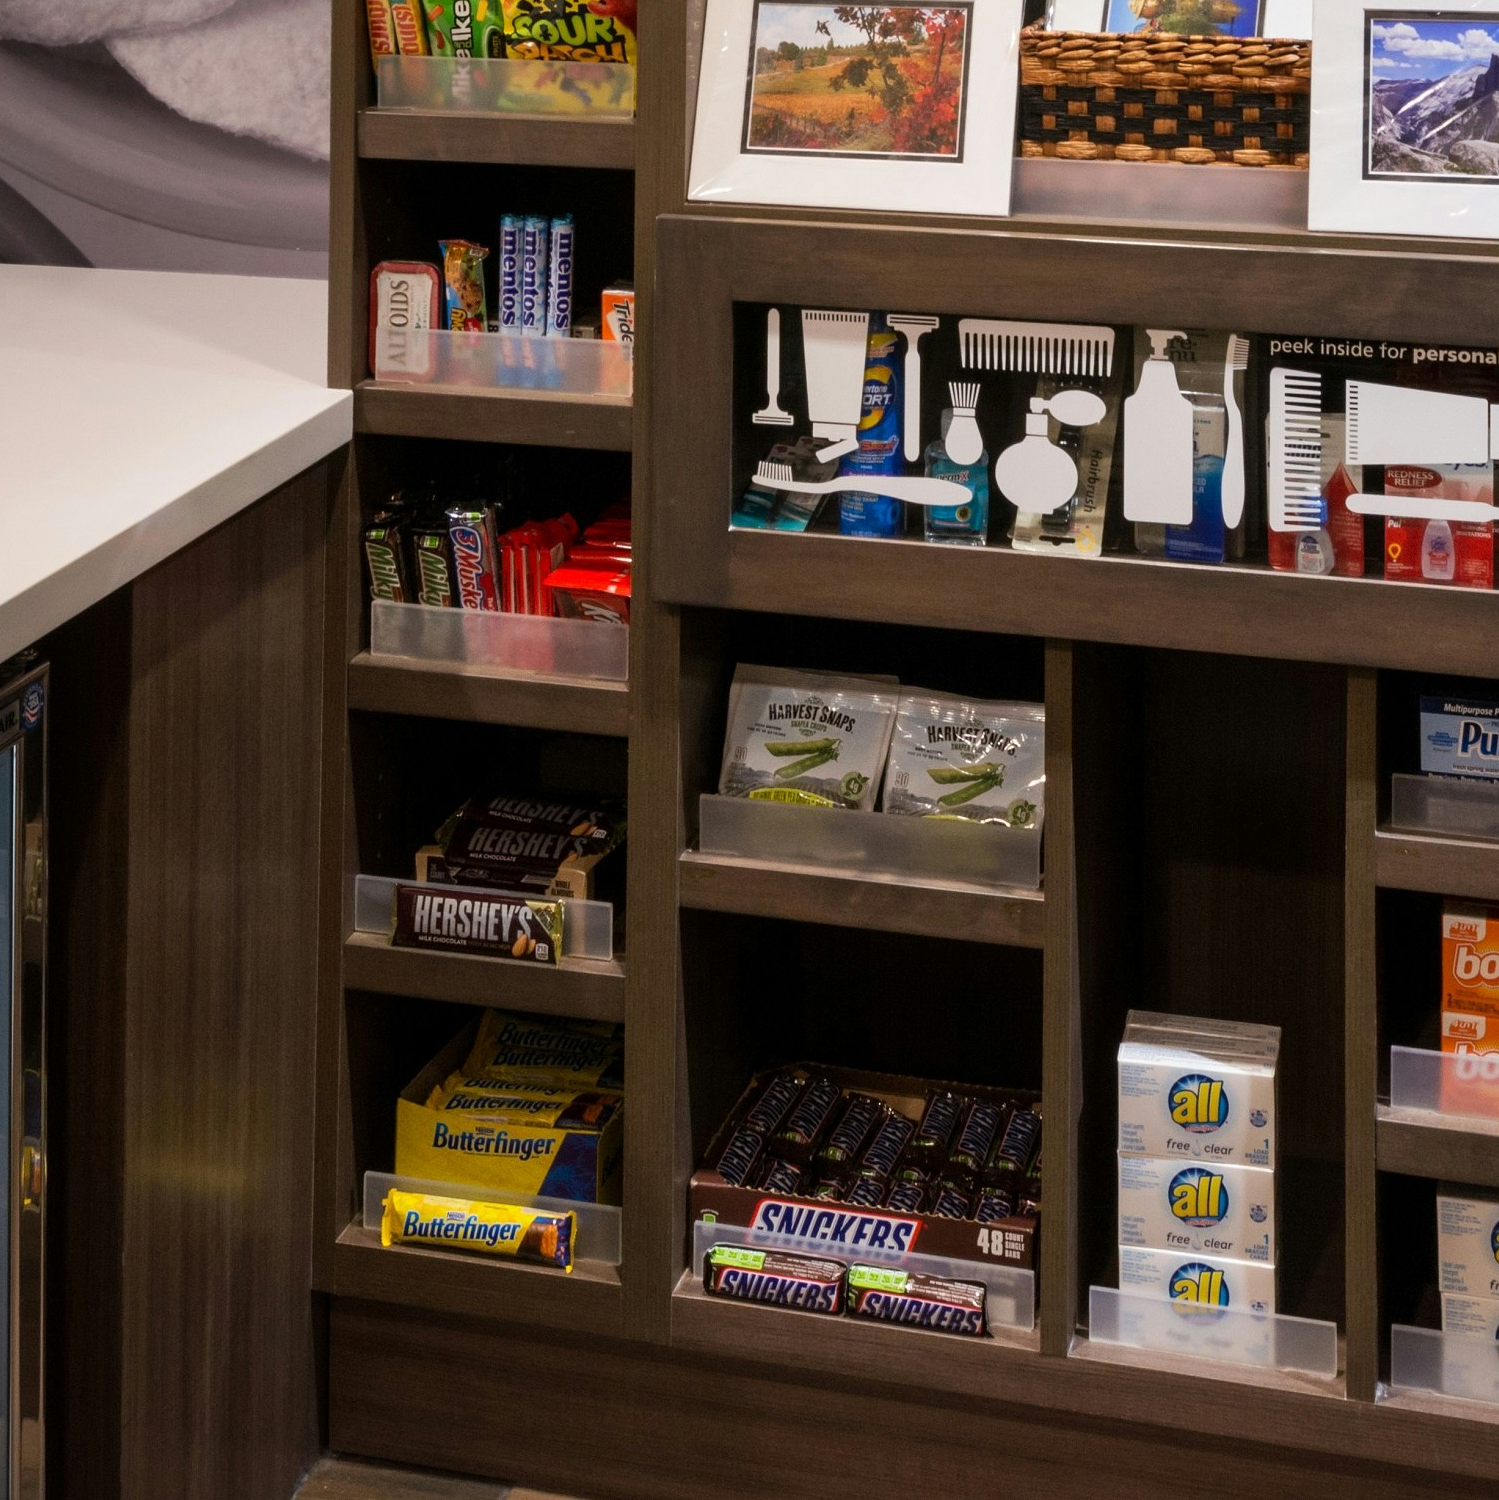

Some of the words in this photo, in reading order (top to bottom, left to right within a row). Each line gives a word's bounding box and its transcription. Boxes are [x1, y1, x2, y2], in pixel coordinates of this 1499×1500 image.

[512, 15, 616, 46] SOUR
[503, 229, 518, 327] mentos
[523, 229, 538, 327] mentos
[556, 231, 573, 329] mentos
[1270, 338, 1314, 356] peek
[1320, 340, 1373, 358] inside
[1380, 342, 1408, 359] for
[1084, 449, 1103, 513] Hairbrush
[1388, 470, 1434, 479] REDNESS
[1394, 478, 1426, 486] RELIEF
[366, 542, 401, 602] Milky
[418, 550, 450, 607] Milky
[769, 703, 819, 721] HARVEST
[820, 705, 856, 734] SNAPS.
[1444, 703, 1493, 716] Multipurpose
[414, 895, 532, 942] HERSHEY'S
[1171, 1081, 1224, 1124] all
[433, 1123, 556, 1161] Butterfinger
[1167, 1138, 1190, 1151] free
[1204, 1143, 1233, 1156] clear
[1264, 1139, 1269, 1149] 1
[1171, 1175, 1223, 1218] all
[403, 1211, 521, 1246] Butterfinger
[977, 1228, 1003, 1255] 48
[1167, 1232, 1190, 1245] free
[1204, 1238, 1233, 1250] clear
[1263, 1234, 1269, 1244] 1
[722, 1270, 837, 1311] SNICKERS
[862, 1292, 981, 1334] SNICKERS
